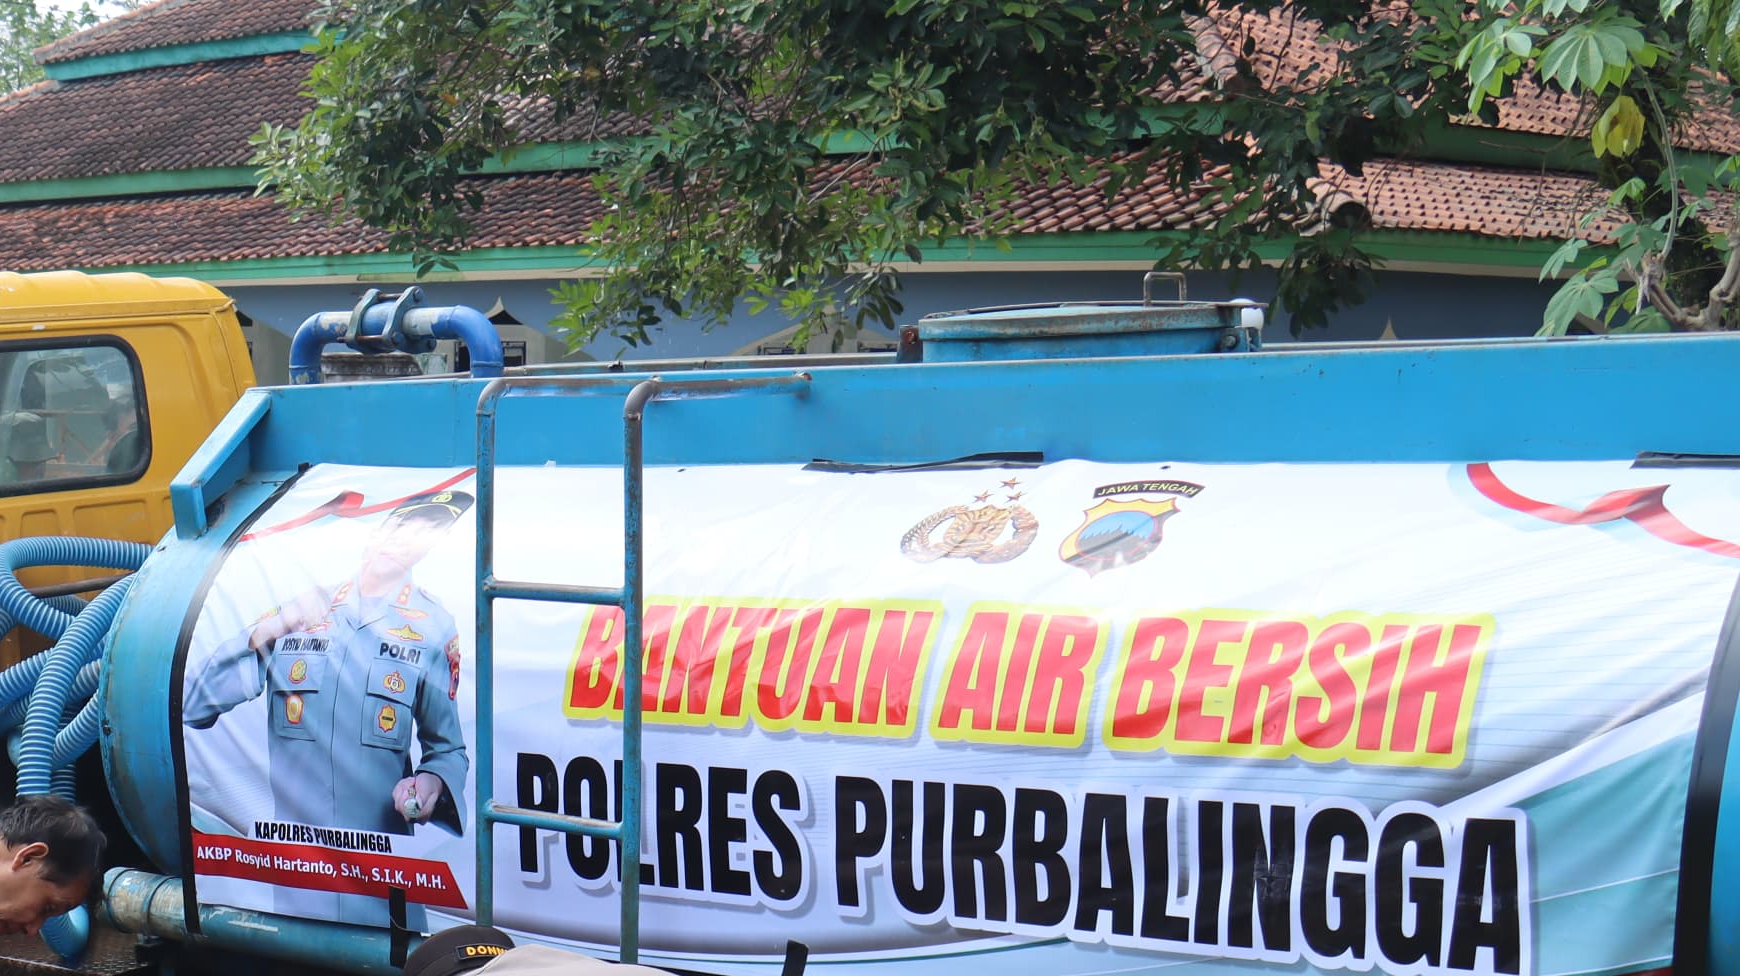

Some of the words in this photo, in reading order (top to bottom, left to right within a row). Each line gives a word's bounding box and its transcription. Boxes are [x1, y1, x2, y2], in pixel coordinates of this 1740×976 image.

[1098, 484, 1138, 496] JAWA
[1142, 483, 1198, 495] TENGAH
[379, 642, 421, 664] POLRI
[570, 605, 933, 726] BANTUAN
[939, 611, 1098, 735] AIR
[1113, 616, 1481, 754] BERSIH
[255, 821, 313, 844] KAPOLRES
[315, 827, 392, 853] PURBALINGGA
[197, 846, 232, 861] AKBP
[235, 849, 271, 869] Rosyid
[273, 856, 337, 878] Hartanto,
[341, 863, 369, 882] S.H.,
[372, 867, 412, 888] S.I.K.,
[416, 872, 446, 889] M.H.
[835, 775, 1520, 976] PURBALINGGA
[466, 946, 507, 956] DONN
